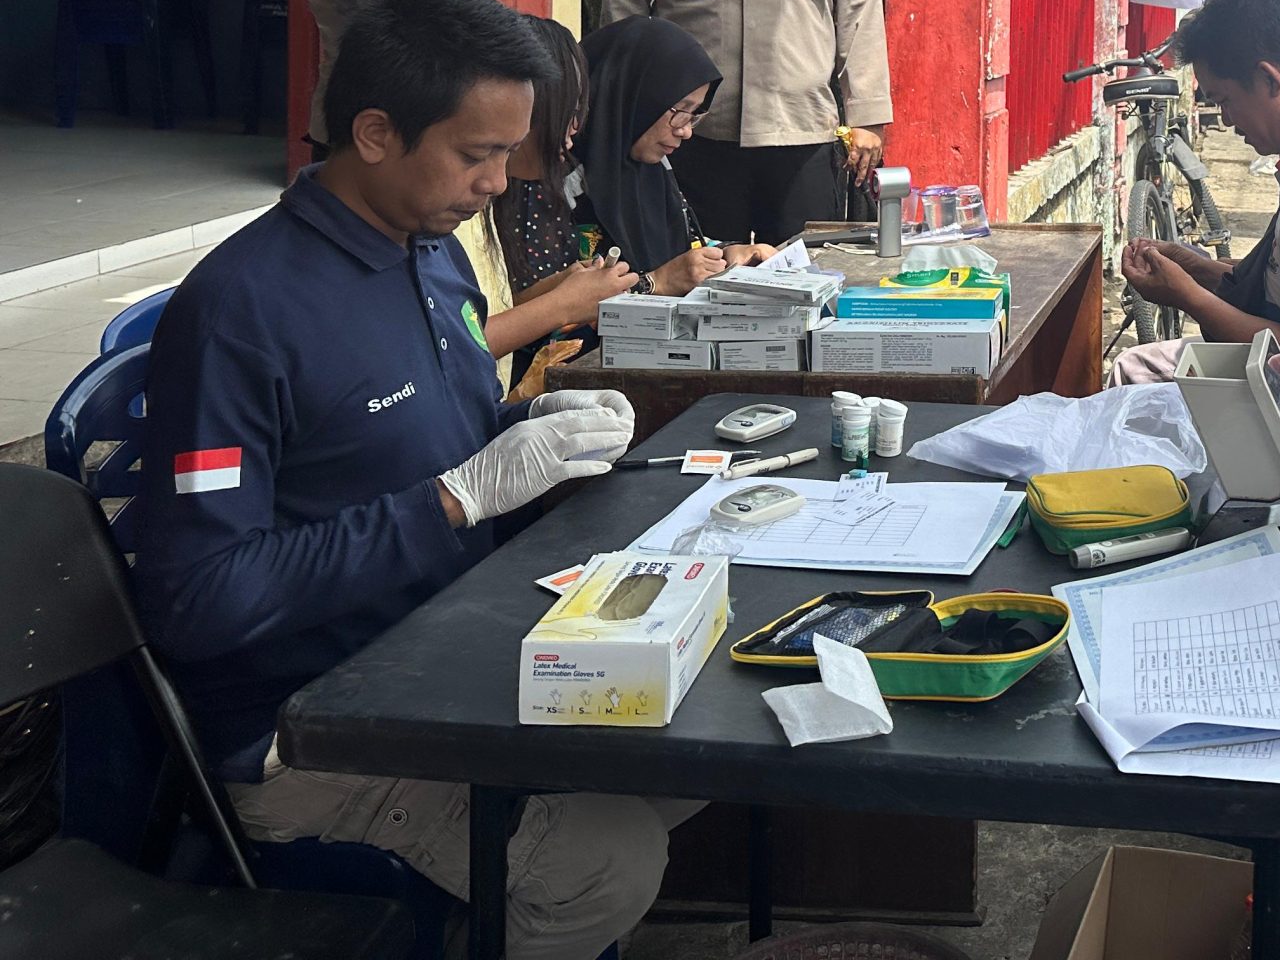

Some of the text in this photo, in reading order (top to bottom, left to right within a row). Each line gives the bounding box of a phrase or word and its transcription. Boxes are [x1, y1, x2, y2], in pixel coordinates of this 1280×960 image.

[368, 381, 416, 413] Sendi
[533, 662, 577, 670] Latex Medical
[573, 670, 594, 678] Gloves
